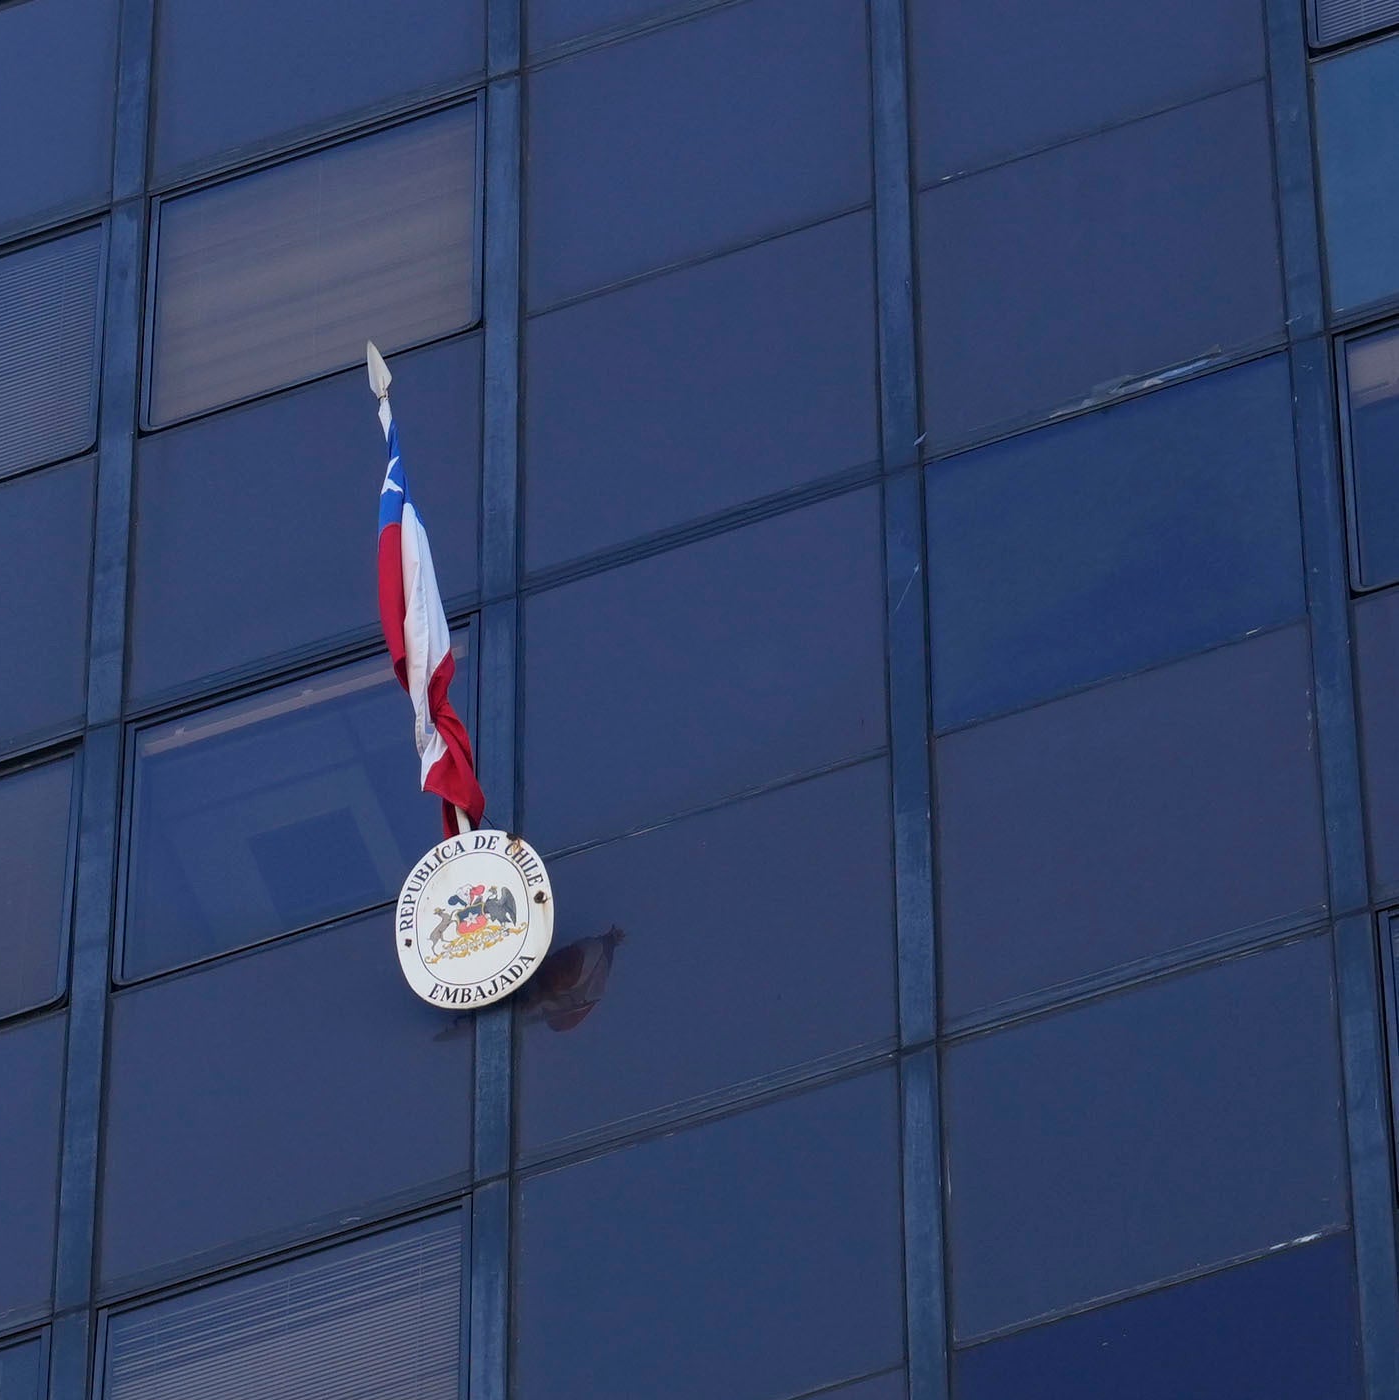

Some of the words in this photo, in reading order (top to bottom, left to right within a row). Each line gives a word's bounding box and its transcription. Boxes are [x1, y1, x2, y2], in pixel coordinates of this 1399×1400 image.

[474, 835, 500, 850] DE
[505, 841, 544, 887] CHILE
[428, 954, 536, 1003] EMBAJADA
